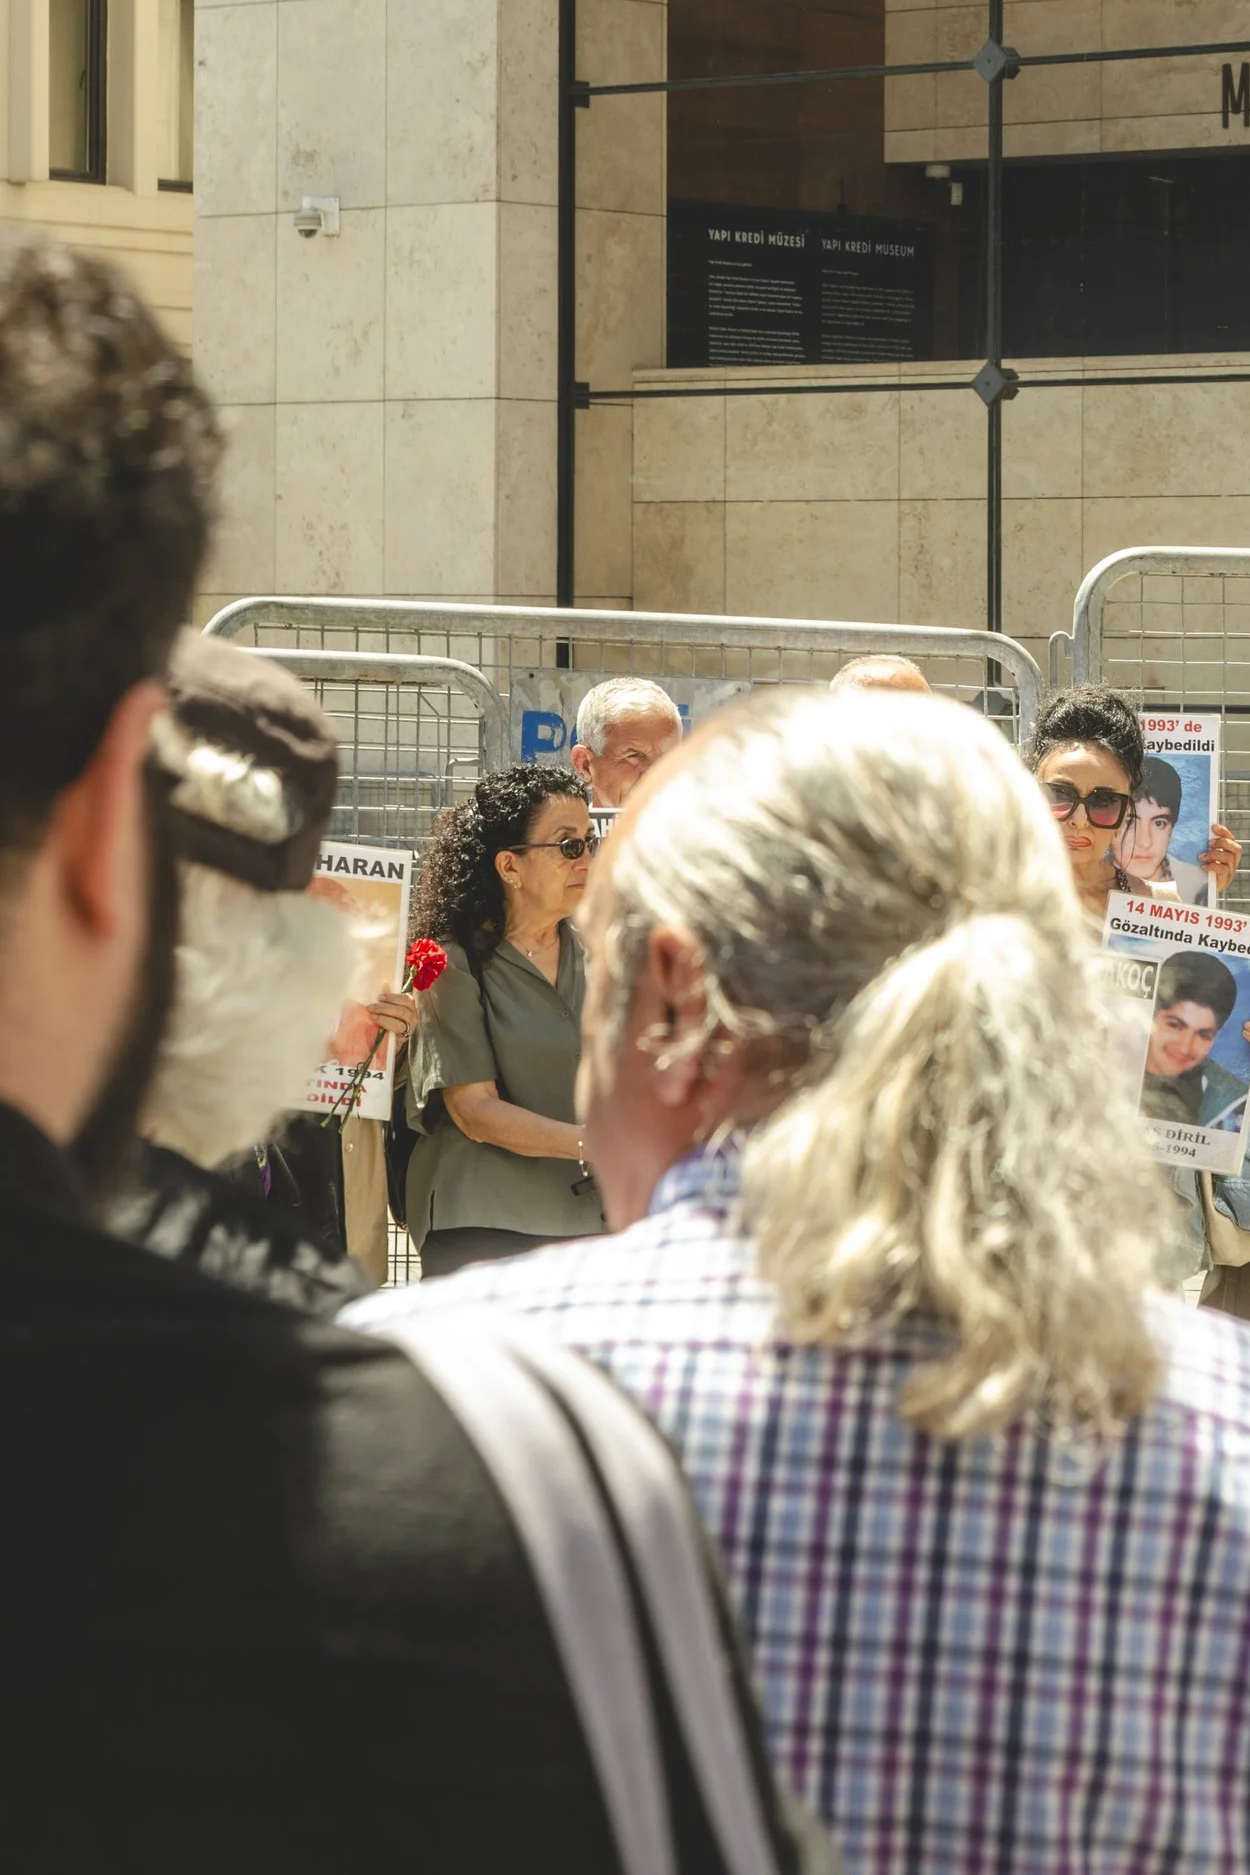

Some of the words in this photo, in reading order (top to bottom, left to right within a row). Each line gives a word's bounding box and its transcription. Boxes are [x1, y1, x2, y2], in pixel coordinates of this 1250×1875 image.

[708, 228, 731, 242] YAPI
[735, 230, 765, 244] KREDİ
[768, 232, 805, 248] MÜZESİ
[821, 238, 841, 251] YAPI
[845, 239, 872, 254] KREDİ
[875, 243, 914, 257] MUSEUM
[1184, 720, 1203, 733] de
[1143, 738, 1215, 753] aybedildi
[1126, 900, 1145, 915] 14
[1149, 904, 1200, 925] MAYIS
[1110, 918, 1193, 944] Gözaltında
[1165, 1128, 1211, 1146] DİRİL
